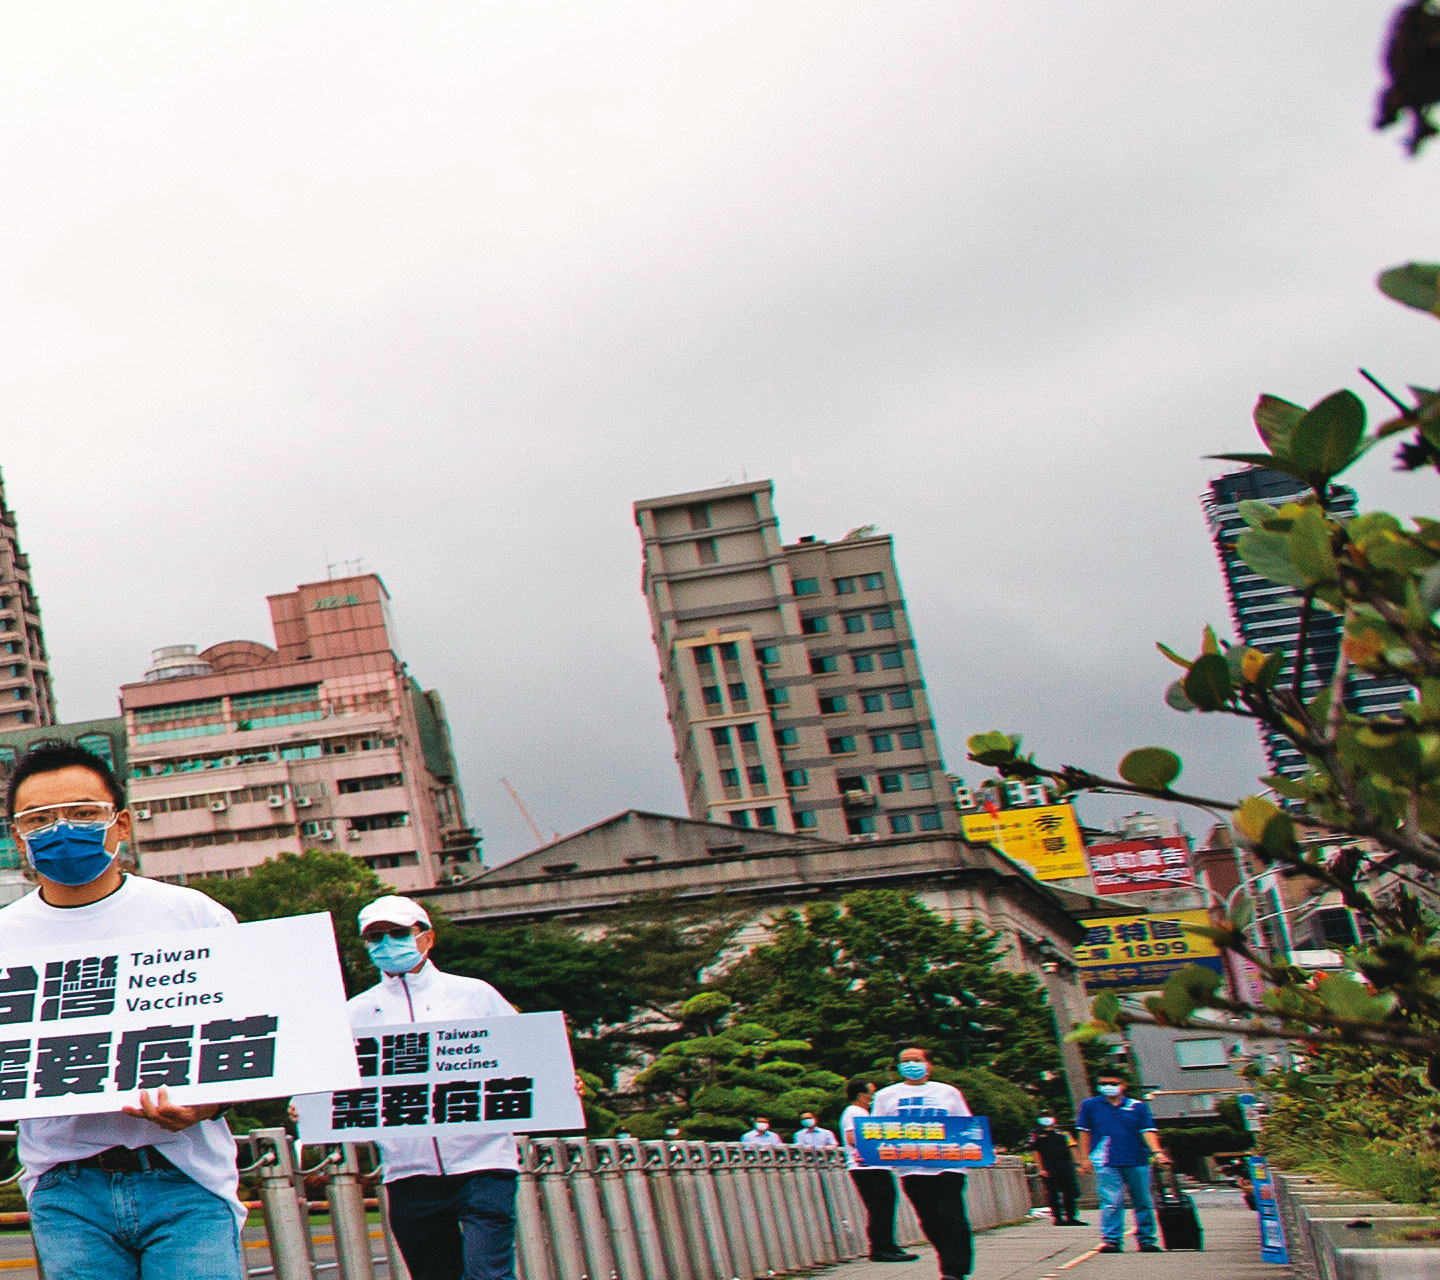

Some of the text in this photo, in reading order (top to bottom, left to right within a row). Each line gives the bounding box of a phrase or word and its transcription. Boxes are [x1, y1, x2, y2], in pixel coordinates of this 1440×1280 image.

[130, 946, 211, 967] Taiwan
[1121, 941, 1189, 958] 1899
[128, 969, 198, 990] Needs
[126, 990, 224, 1012] Vaccines
[437, 1028, 489, 1041] Taiwan
[436, 1043, 481, 1056] Needs
[436, 1058, 499, 1071] Vaccines
[331, 1076, 533, 1130] 需要疫苗
